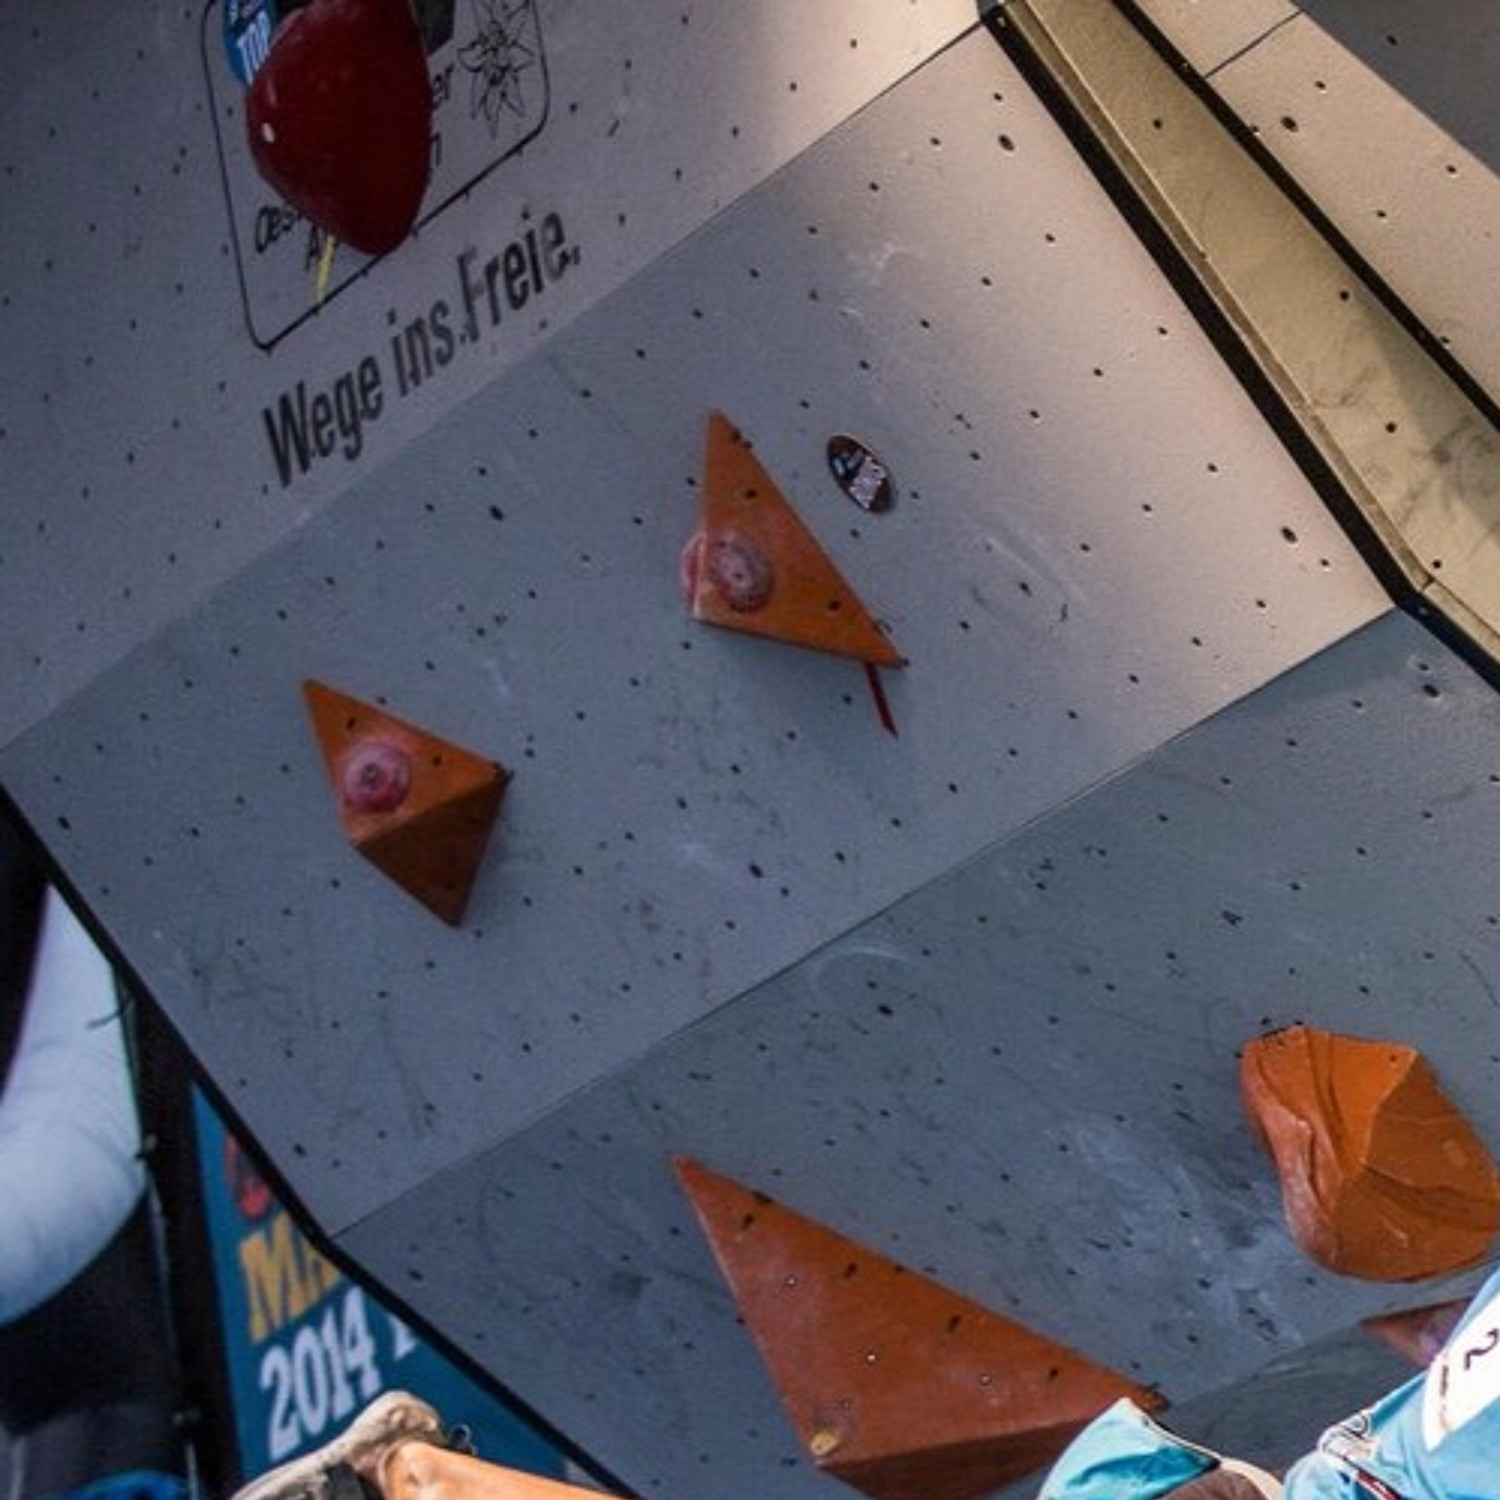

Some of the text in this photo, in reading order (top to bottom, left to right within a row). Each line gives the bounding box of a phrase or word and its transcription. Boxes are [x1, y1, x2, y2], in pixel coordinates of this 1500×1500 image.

[262, 355, 384, 489] Wege
[261, 1284, 382, 1461] 2014
[1463, 1327, 1500, 1371] 2
